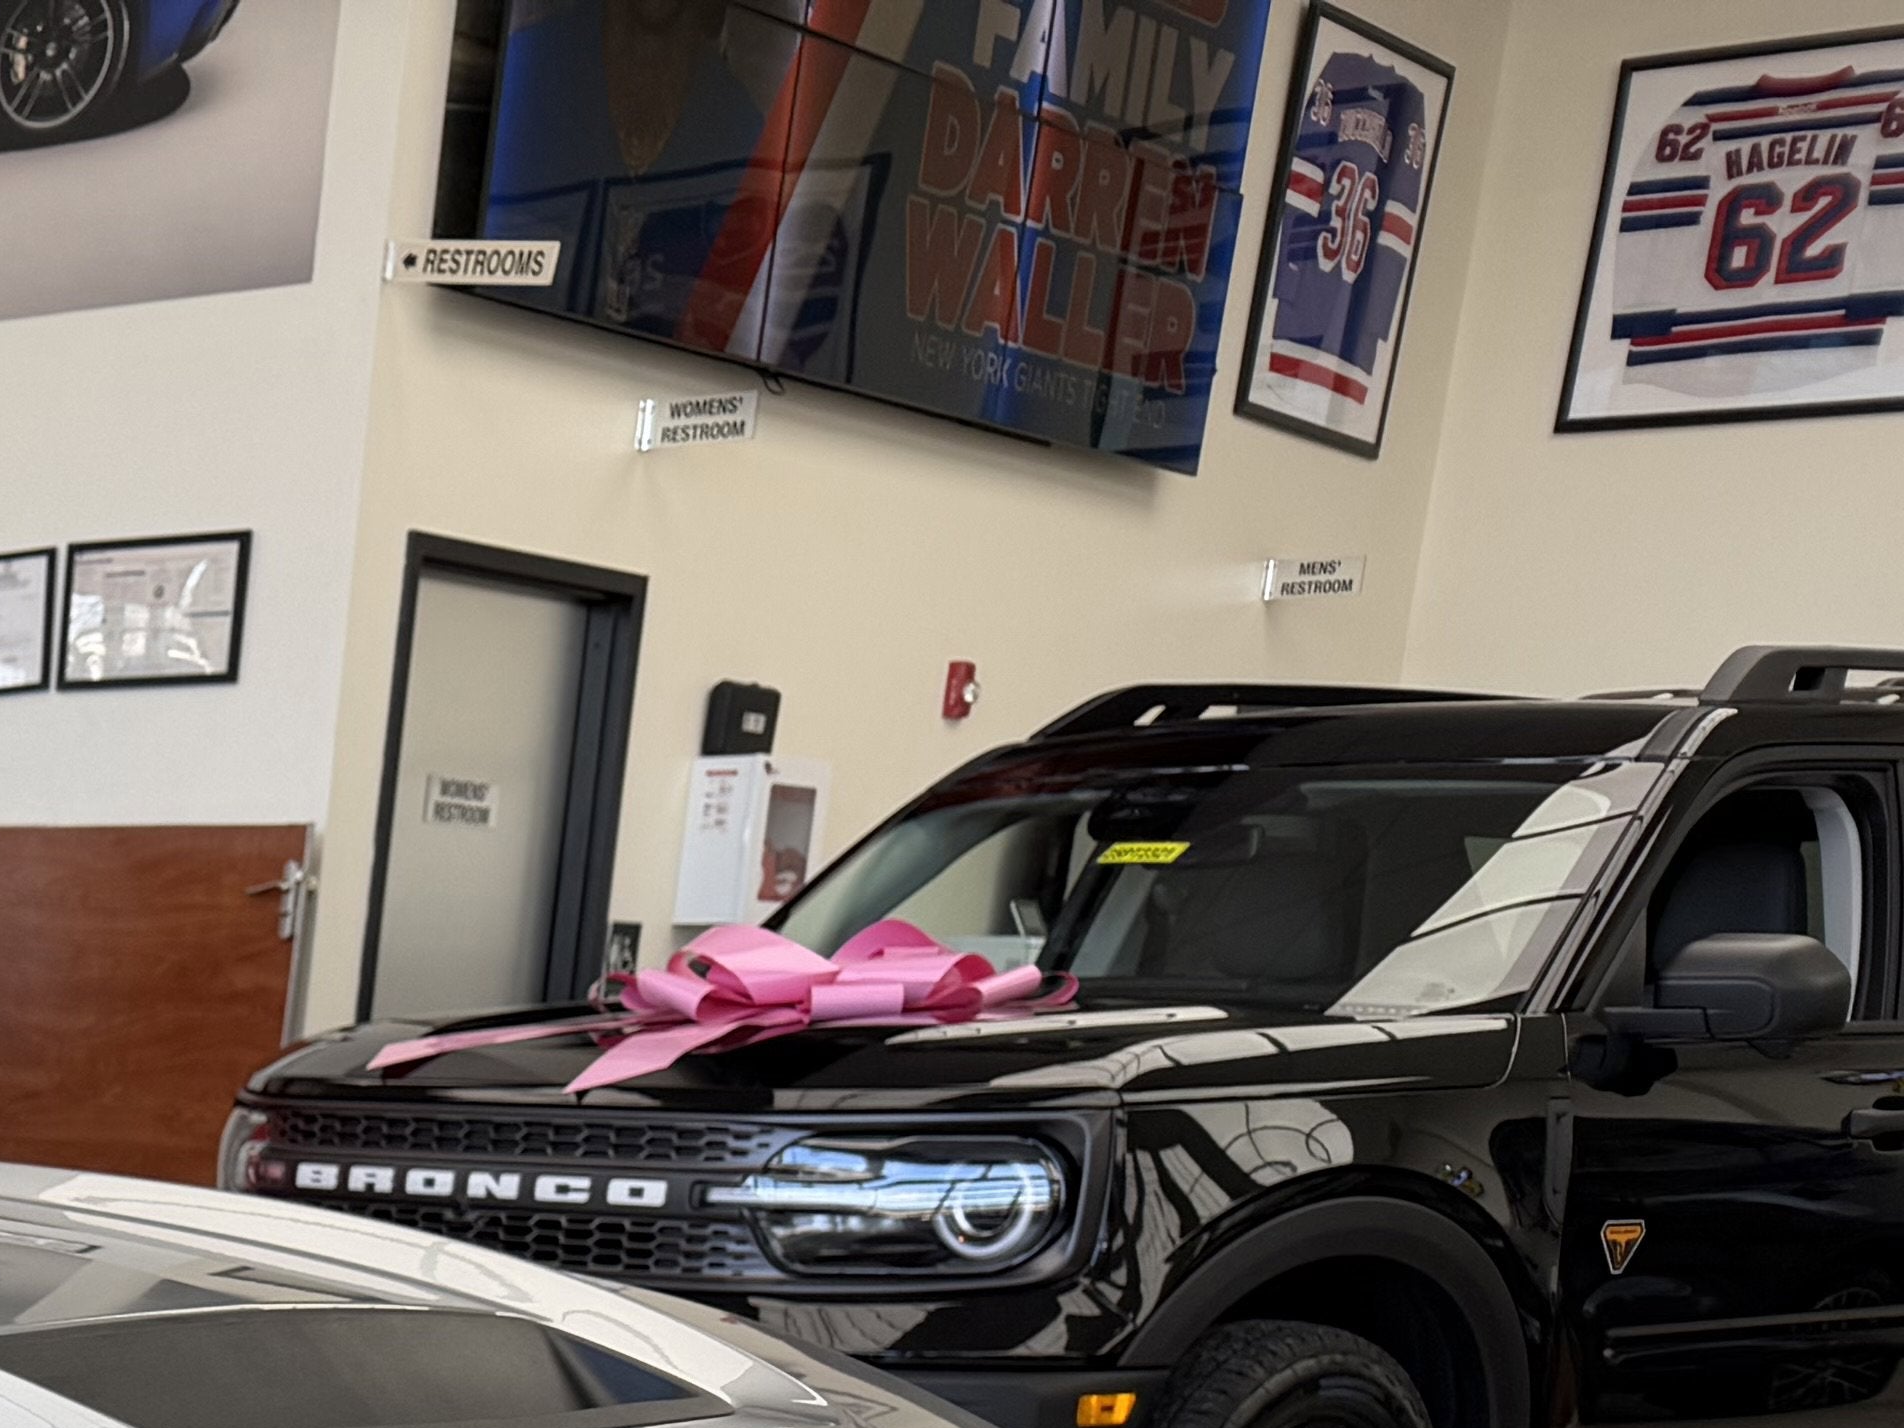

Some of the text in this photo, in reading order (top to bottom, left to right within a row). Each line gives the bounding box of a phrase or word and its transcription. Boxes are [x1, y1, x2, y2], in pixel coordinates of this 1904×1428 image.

[972, 0, 1235, 152] FAMILY
[1655, 121, 1712, 163] 62
[1725, 133, 1858, 181] HAGELIN
[919, 60, 1218, 283] DARREN
[1316, 160, 1380, 285] 36
[1704, 171, 1862, 291] 62
[422, 248, 546, 277] RESTROOMS
[905, 194, 1196, 396] WALLER
[912, 332, 957, 371] NEW
[961, 347, 1013, 388] YORK
[1014, 362, 1078, 405] GIANTS
[670, 396, 744, 419] WOMENS'
[660, 420, 746, 444] RESTROOM
[1280, 578, 1354, 597] RESTROOM
[1298, 559, 1342, 577] MENS'
[294, 1161, 669, 1208] BRONCO
